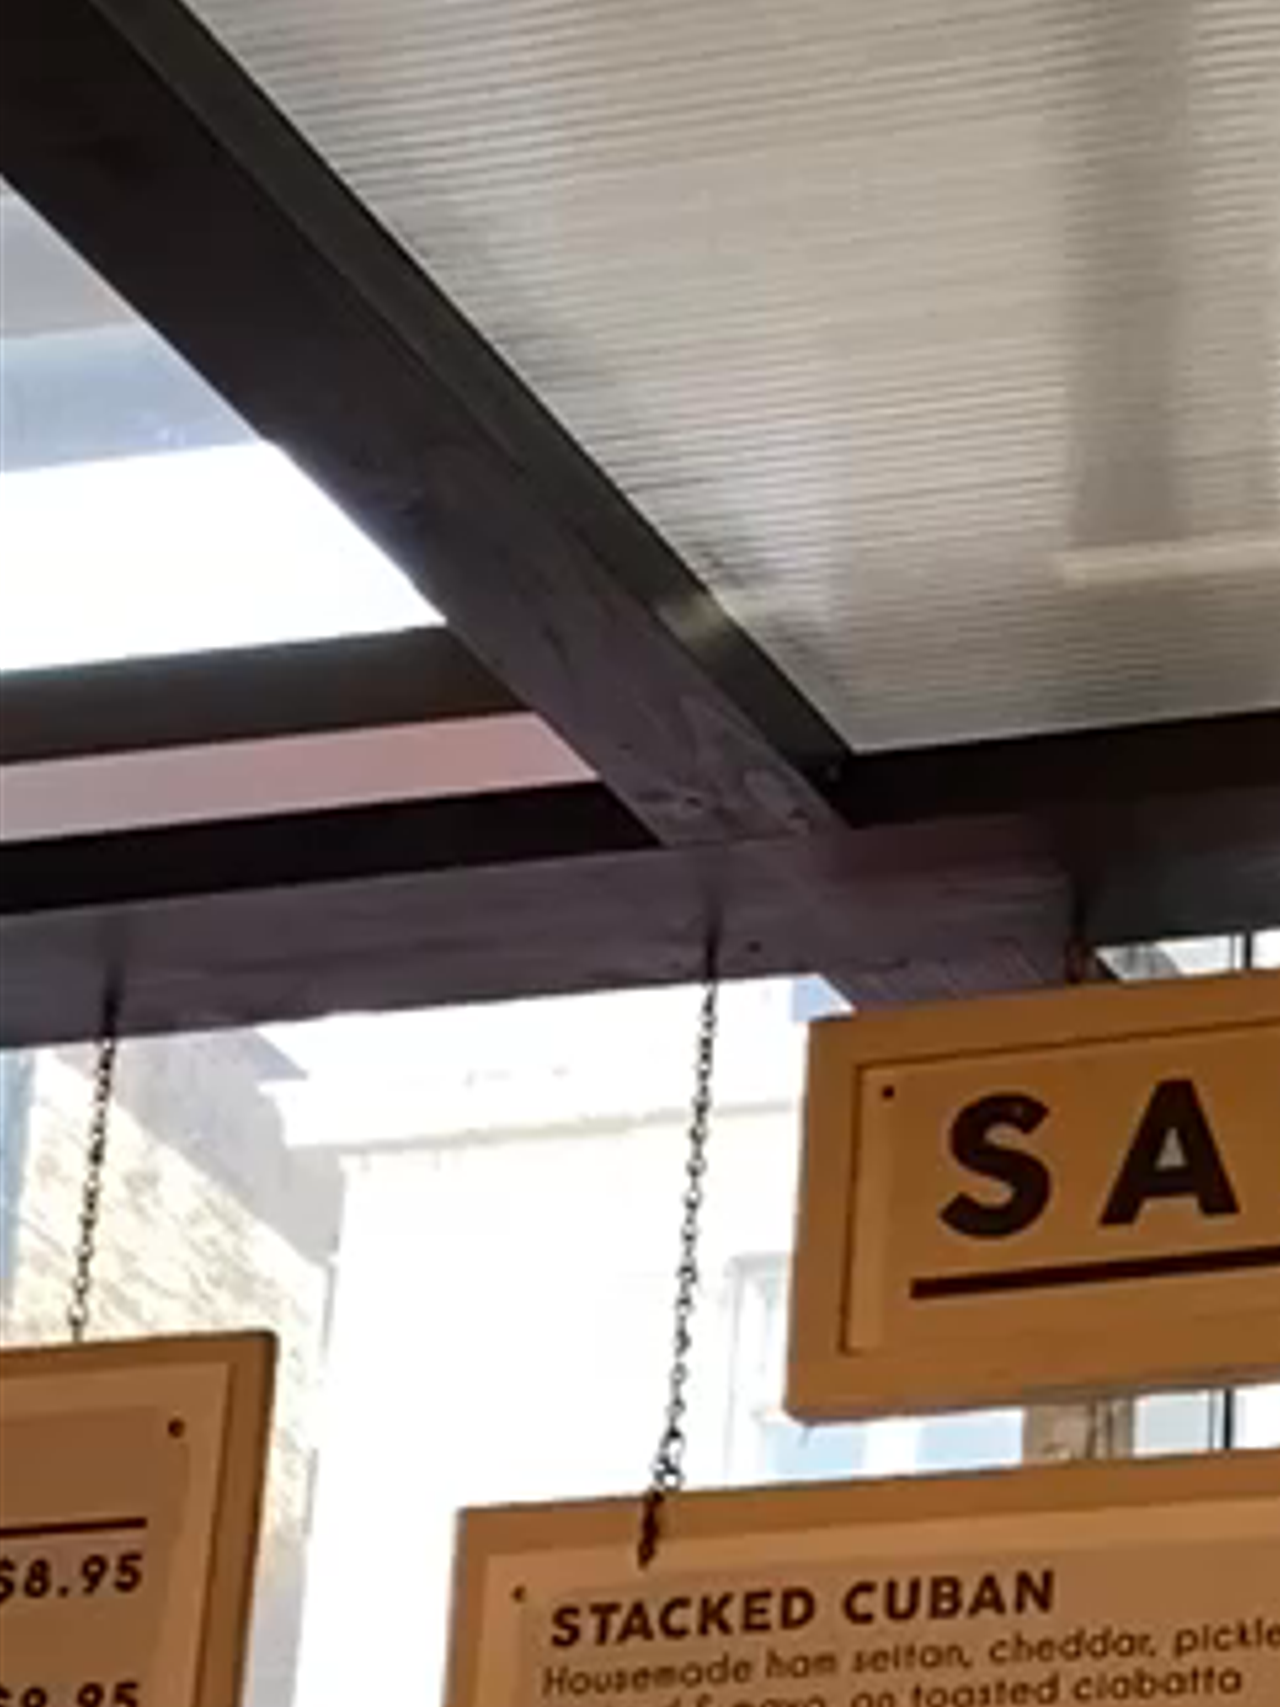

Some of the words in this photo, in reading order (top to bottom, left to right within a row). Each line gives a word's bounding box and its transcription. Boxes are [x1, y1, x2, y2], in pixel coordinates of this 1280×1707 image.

[548, 1584, 819, 1652] STACKED
[839, 1567, 1057, 1627] CUBAN
[540, 1649, 756, 1699] Housemade
[763, 1647, 840, 1681] ham
